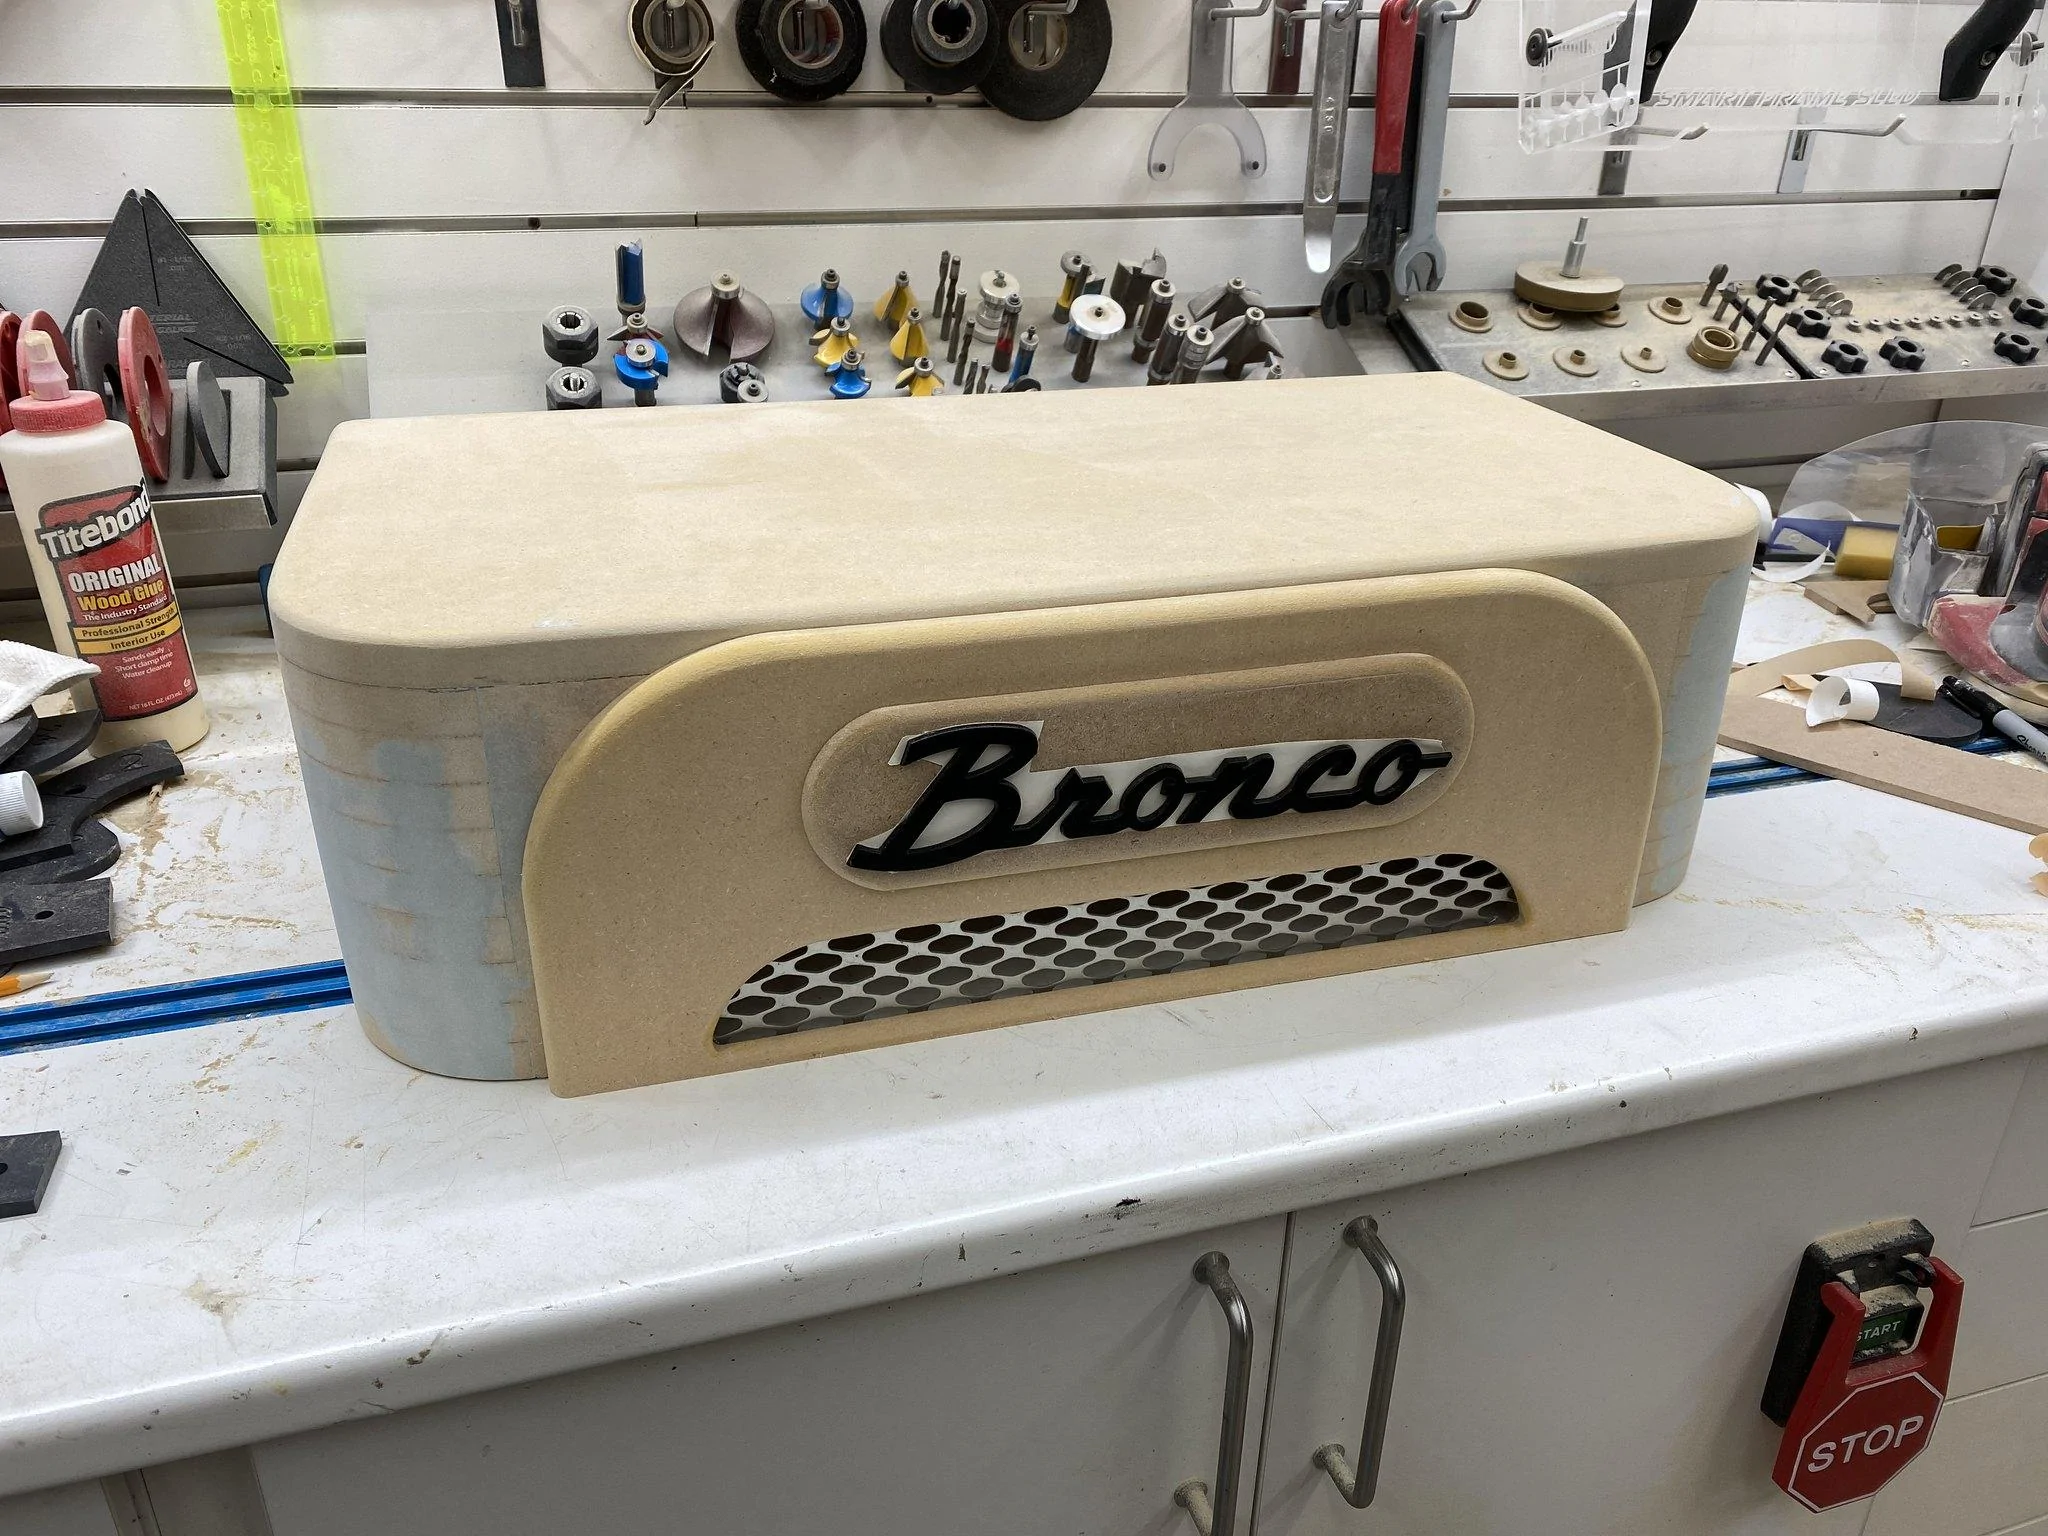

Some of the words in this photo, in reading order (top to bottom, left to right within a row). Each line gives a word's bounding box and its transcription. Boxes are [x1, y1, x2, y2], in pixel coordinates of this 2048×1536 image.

[40, 484, 151, 558] Titebond
[68, 554, 162, 593] ORIGINAL
[77, 589, 132, 611] Wood
[133, 579, 164, 602] Glue
[83, 613, 100, 621] The
[101, 607, 137, 620] Industry
[139, 594, 168, 612] Standard
[82, 620, 144, 637] Professional
[146, 607, 175, 625] Strength
[111, 635, 148, 650] Interior
[150, 629, 166, 640] Use
[114, 663, 137, 673] Short
[137, 658, 160, 668] clamp
[122, 653, 145, 663] Sands
[122, 670, 145, 679] Water
[146, 660, 172, 674] cleanup
[846, 720, 1453, 871] Bronco
[1807, 1415, 1924, 1473] STOP
